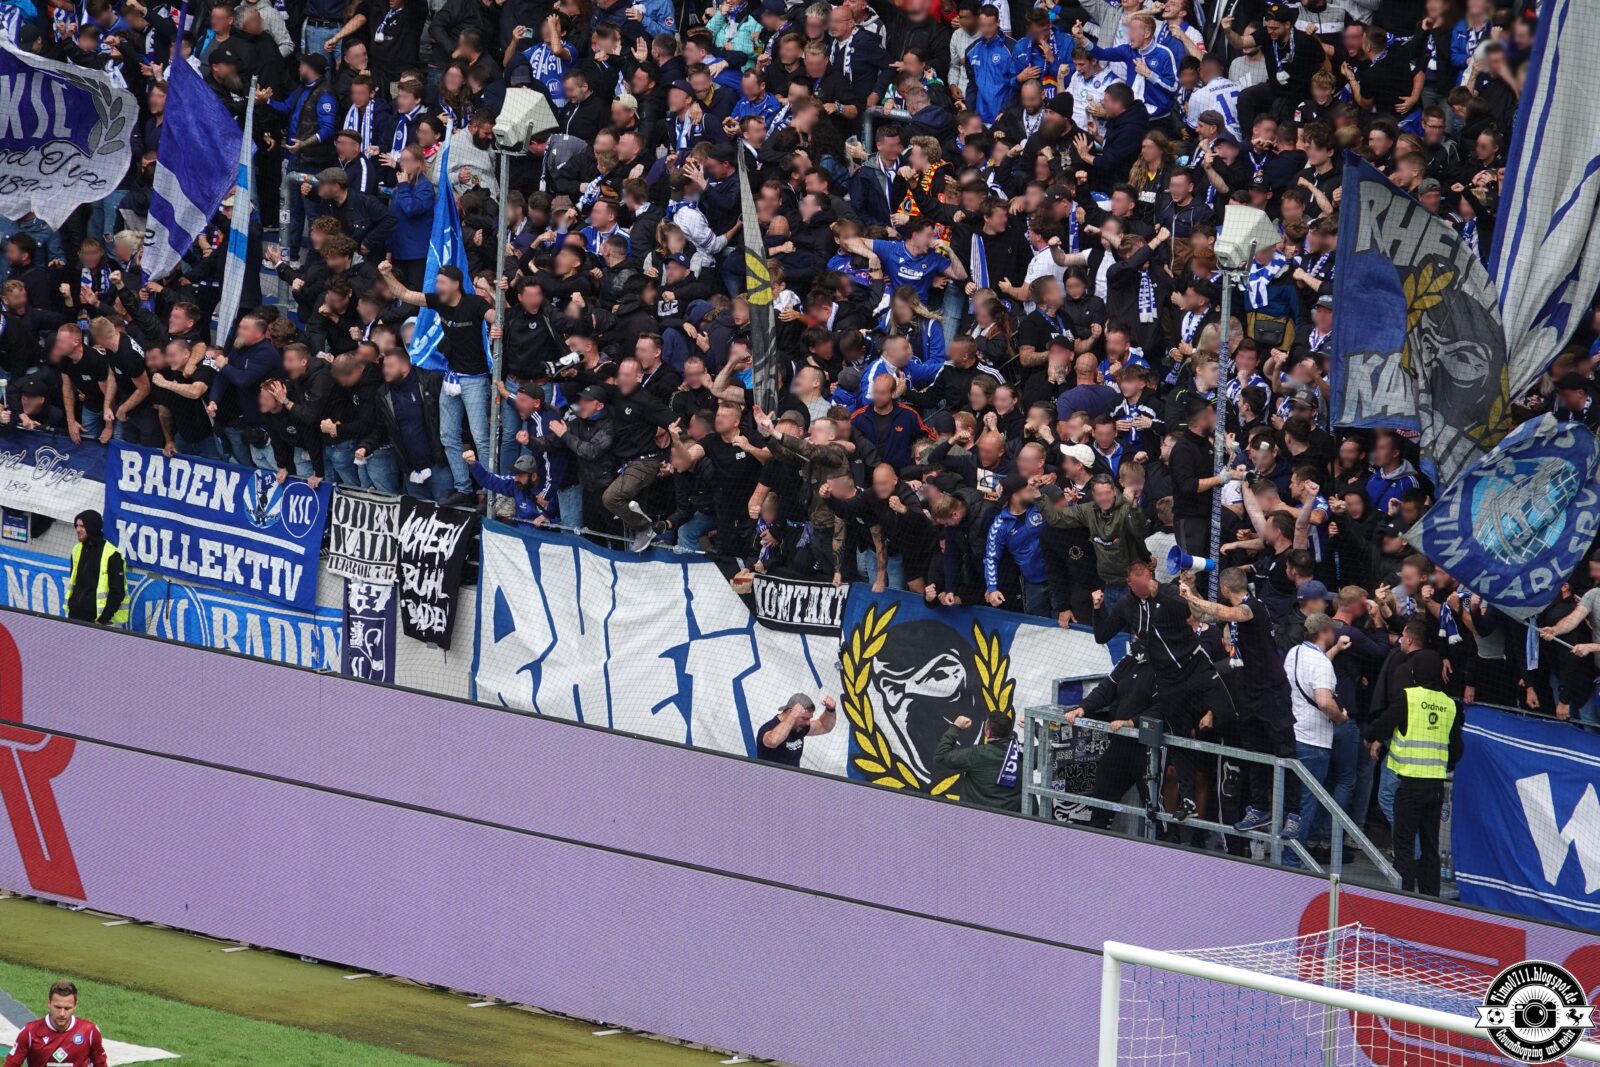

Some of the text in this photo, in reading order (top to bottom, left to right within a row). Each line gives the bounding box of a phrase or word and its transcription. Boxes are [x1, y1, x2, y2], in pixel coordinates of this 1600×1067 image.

[118, 449, 241, 514] BADEN
[288, 494, 314, 526] KSC
[334, 496, 400, 534] ODEN
[116, 518, 304, 602] KOLLEKTIV
[753, 577, 850, 626] KONTAKT
[210, 605, 343, 674] BADEN
[1420, 701, 1448, 713] Ordner
